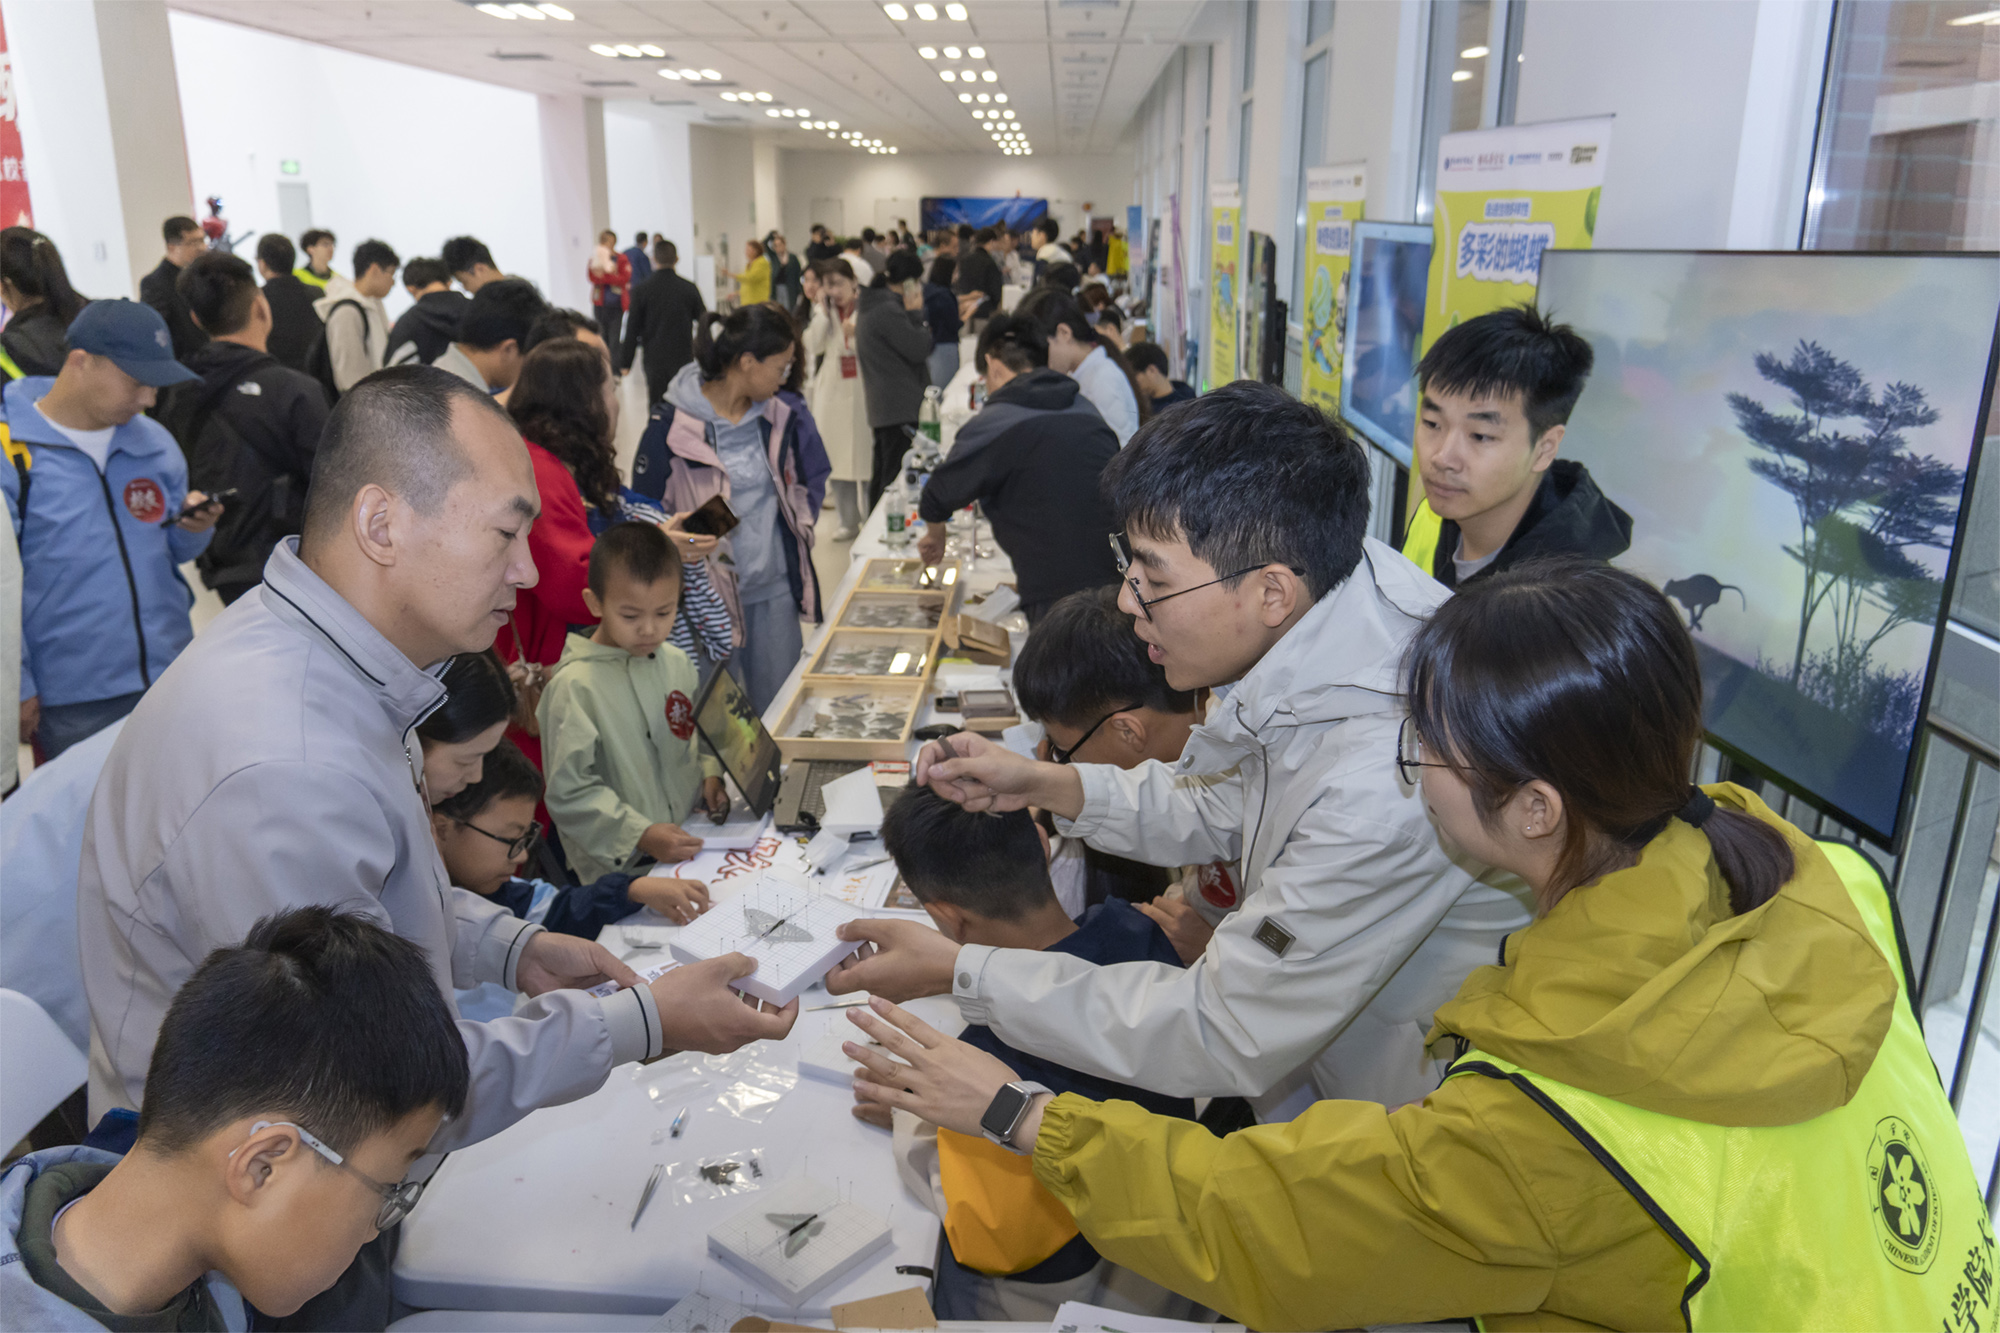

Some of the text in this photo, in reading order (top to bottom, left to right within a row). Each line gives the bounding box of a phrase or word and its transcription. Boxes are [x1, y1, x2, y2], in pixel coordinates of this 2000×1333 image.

[1459, 231, 1549, 275] 多彩的蝴蝶
